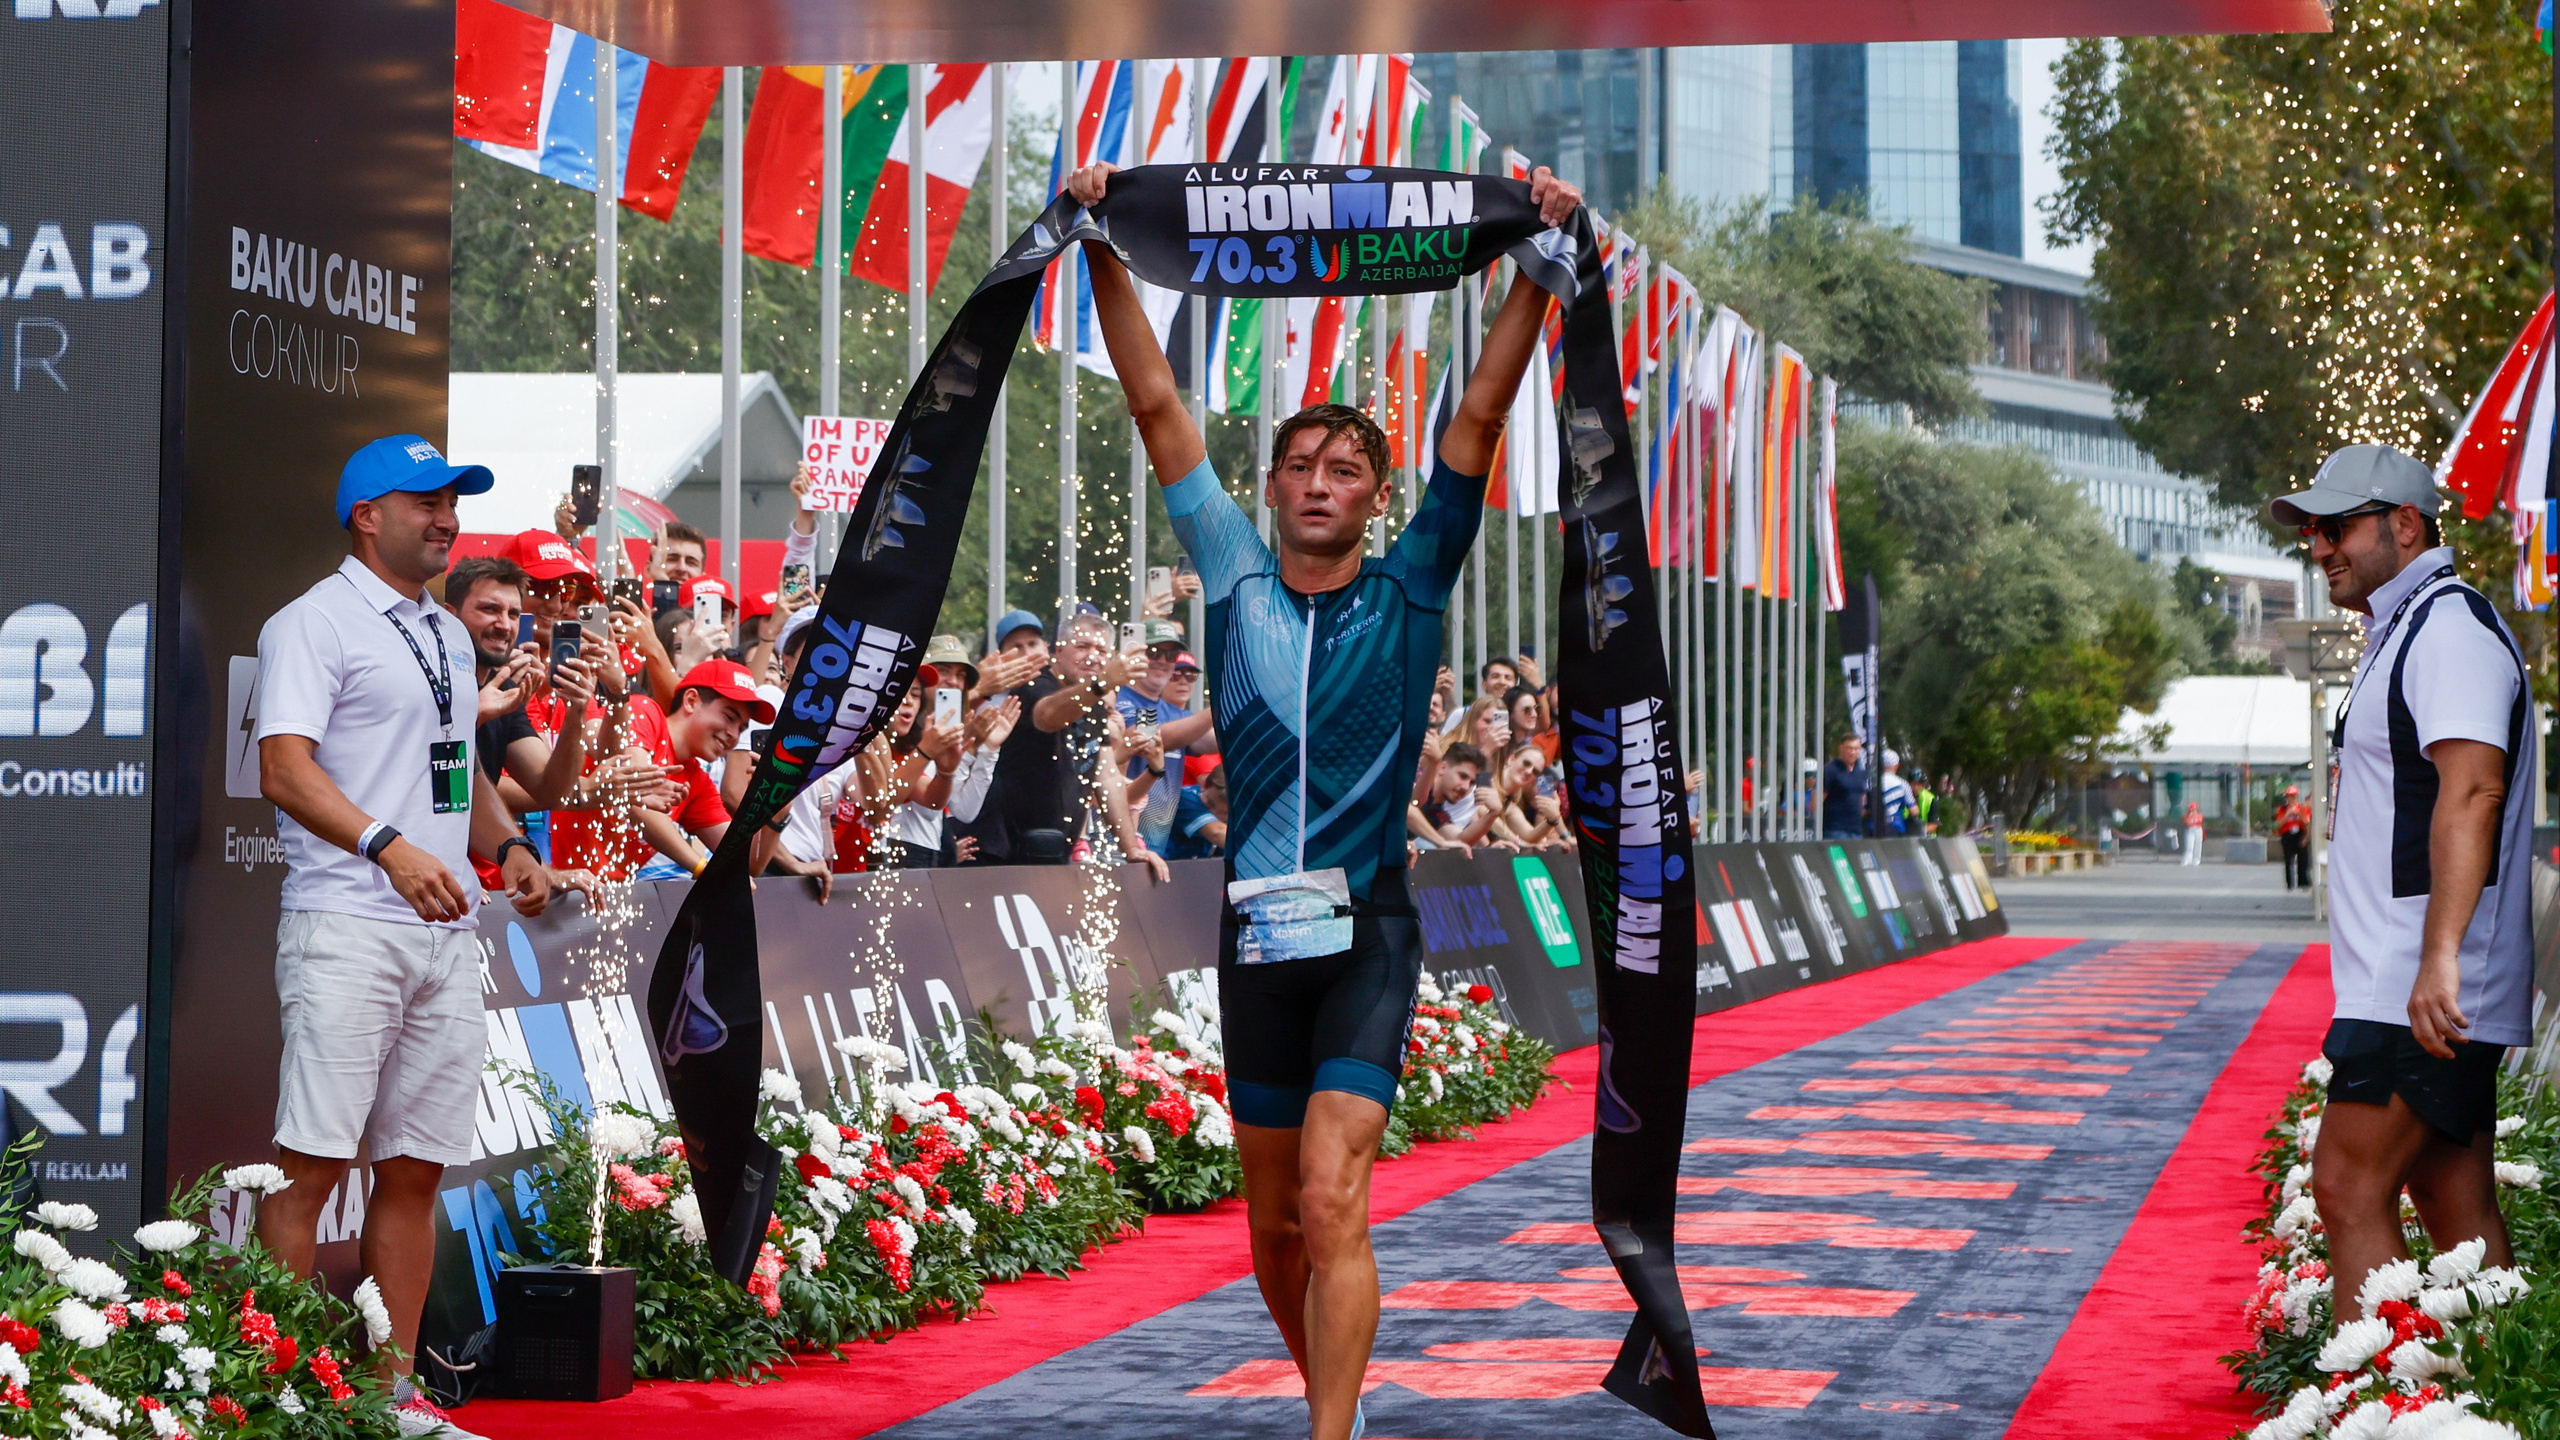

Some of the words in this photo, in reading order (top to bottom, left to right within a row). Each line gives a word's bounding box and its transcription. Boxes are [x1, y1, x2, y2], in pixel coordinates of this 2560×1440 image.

[1185, 166, 1319, 182] ALUFAR
[1185, 180, 1473, 233] IRONMAN
[231, 226, 318, 308] BAKU
[324, 253, 417, 335] CABLE
[1189, 235, 1299, 284] 70.3
[1358, 228, 1470, 265] BAKU
[229, 309, 360, 398] GOKNUR
[807, 443, 842, 464] OF
[852, 446, 870, 466] U
[812, 418, 842, 440] IM
[793, 614, 863, 725] 70.3
[432, 760, 467, 771] TEAM
[1572, 708, 1617, 808] 70.3
[1651, 696, 1679, 829] ALUFAR
[225, 827, 287, 873] Enginee
[1615, 698, 1662, 975] IRONMAN
[1271, 927, 1313, 940] Maxim
[45, 1161, 129, 1180] REKLAM
